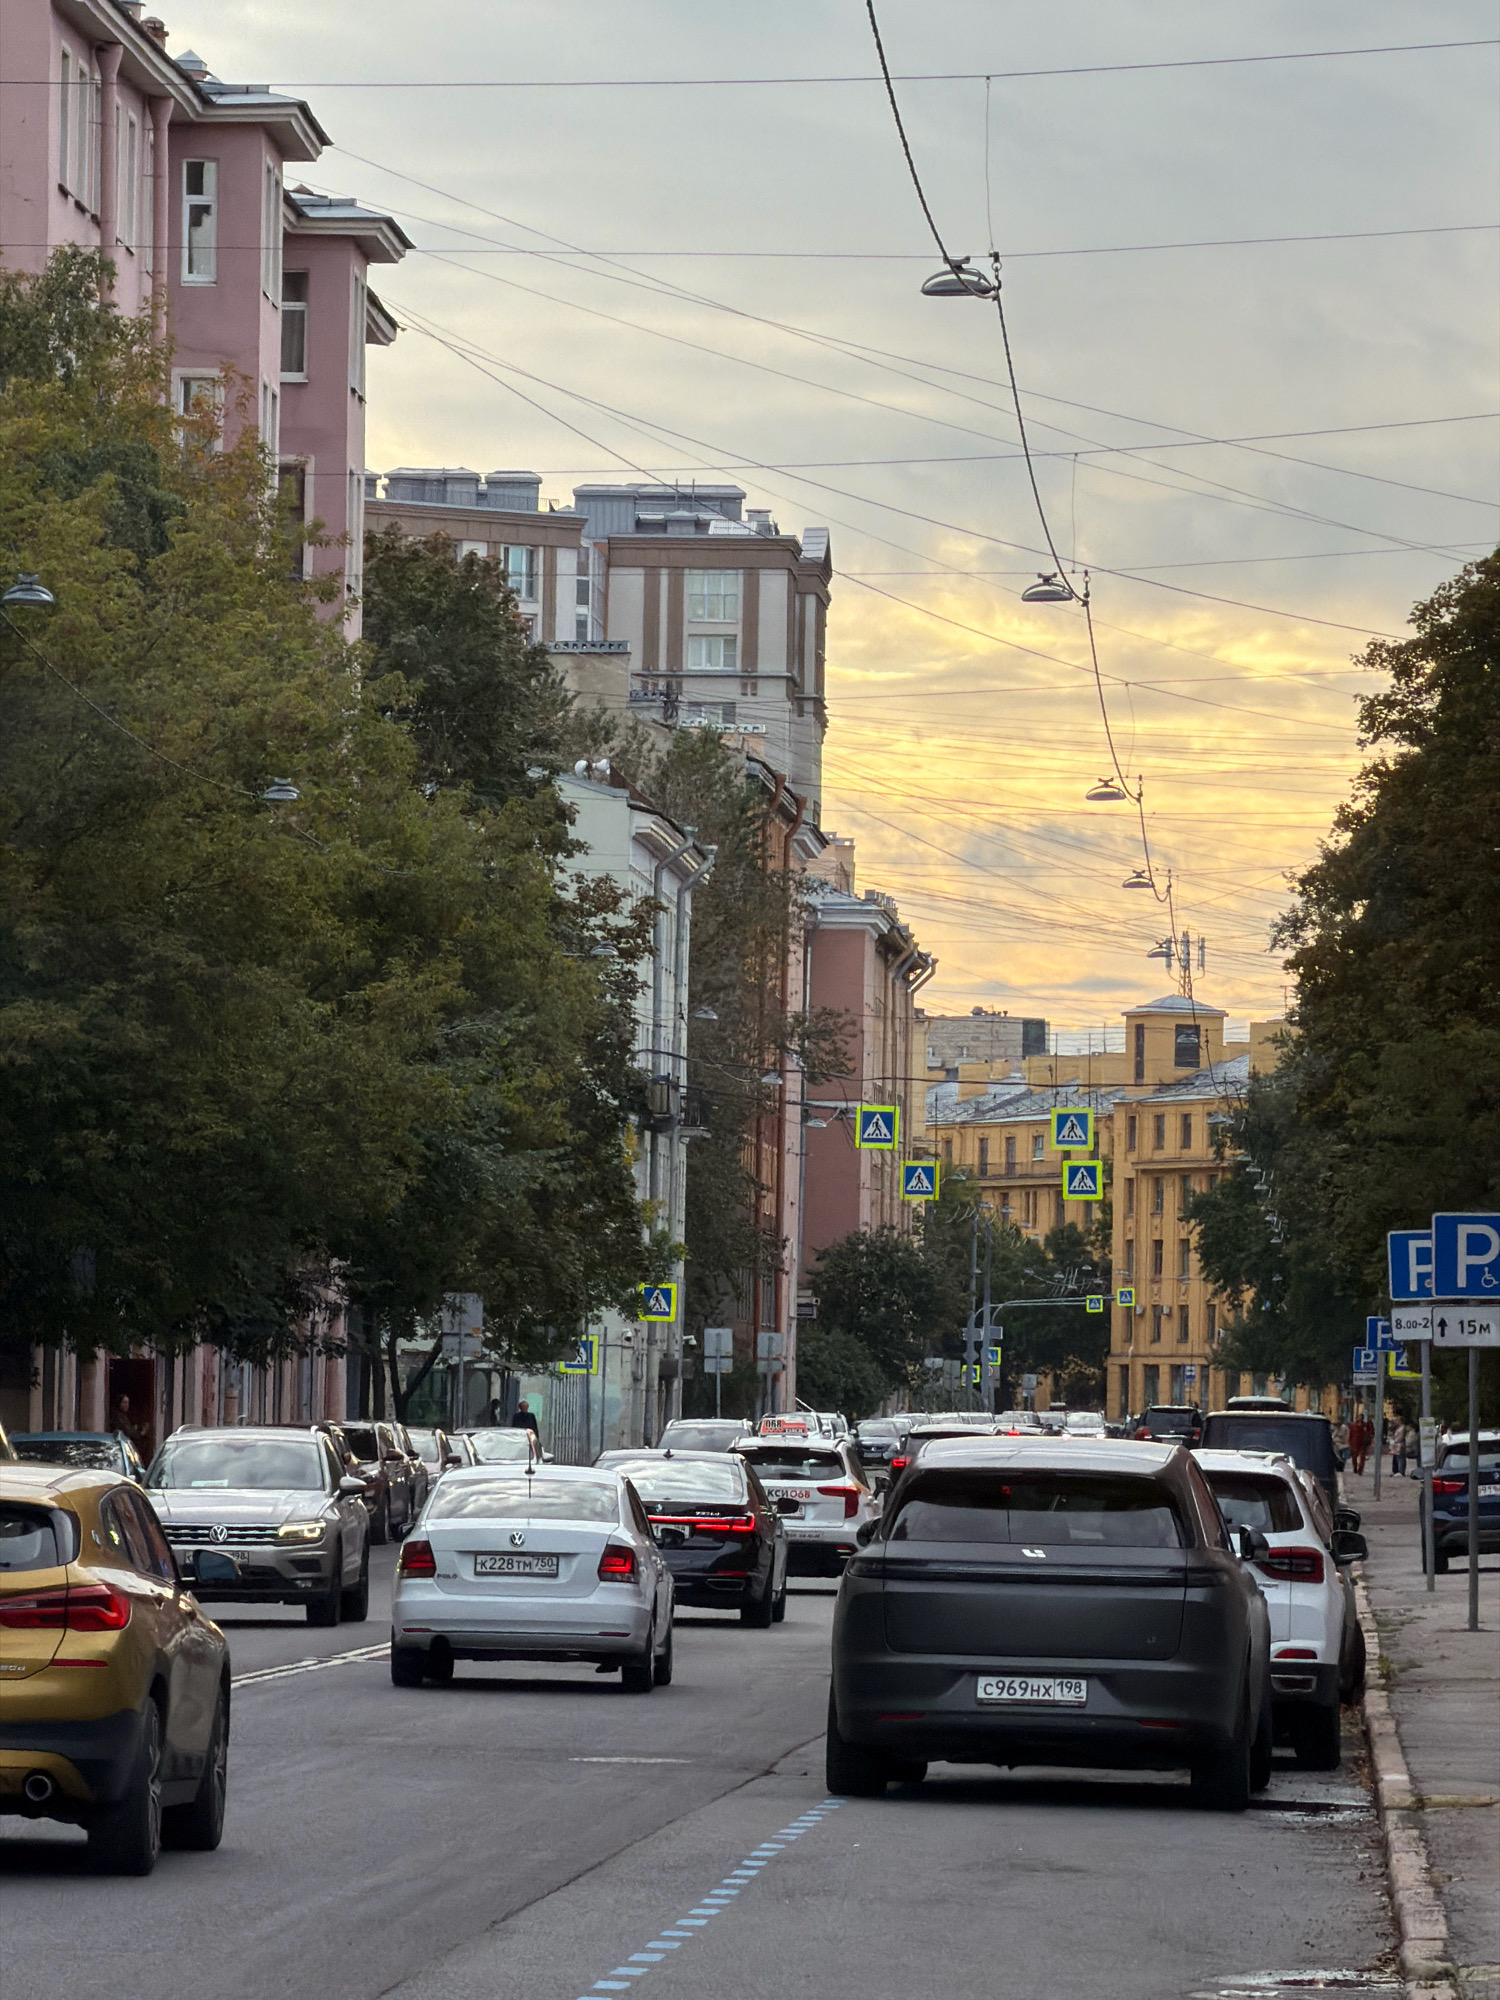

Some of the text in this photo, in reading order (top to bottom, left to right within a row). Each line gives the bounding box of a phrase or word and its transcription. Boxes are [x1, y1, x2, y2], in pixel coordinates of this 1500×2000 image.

[1457, 1224, 1500, 1288] P
[1395, 1317, 1432, 1330] 8.00-2
[1057, 1681, 1082, 1694] 198
